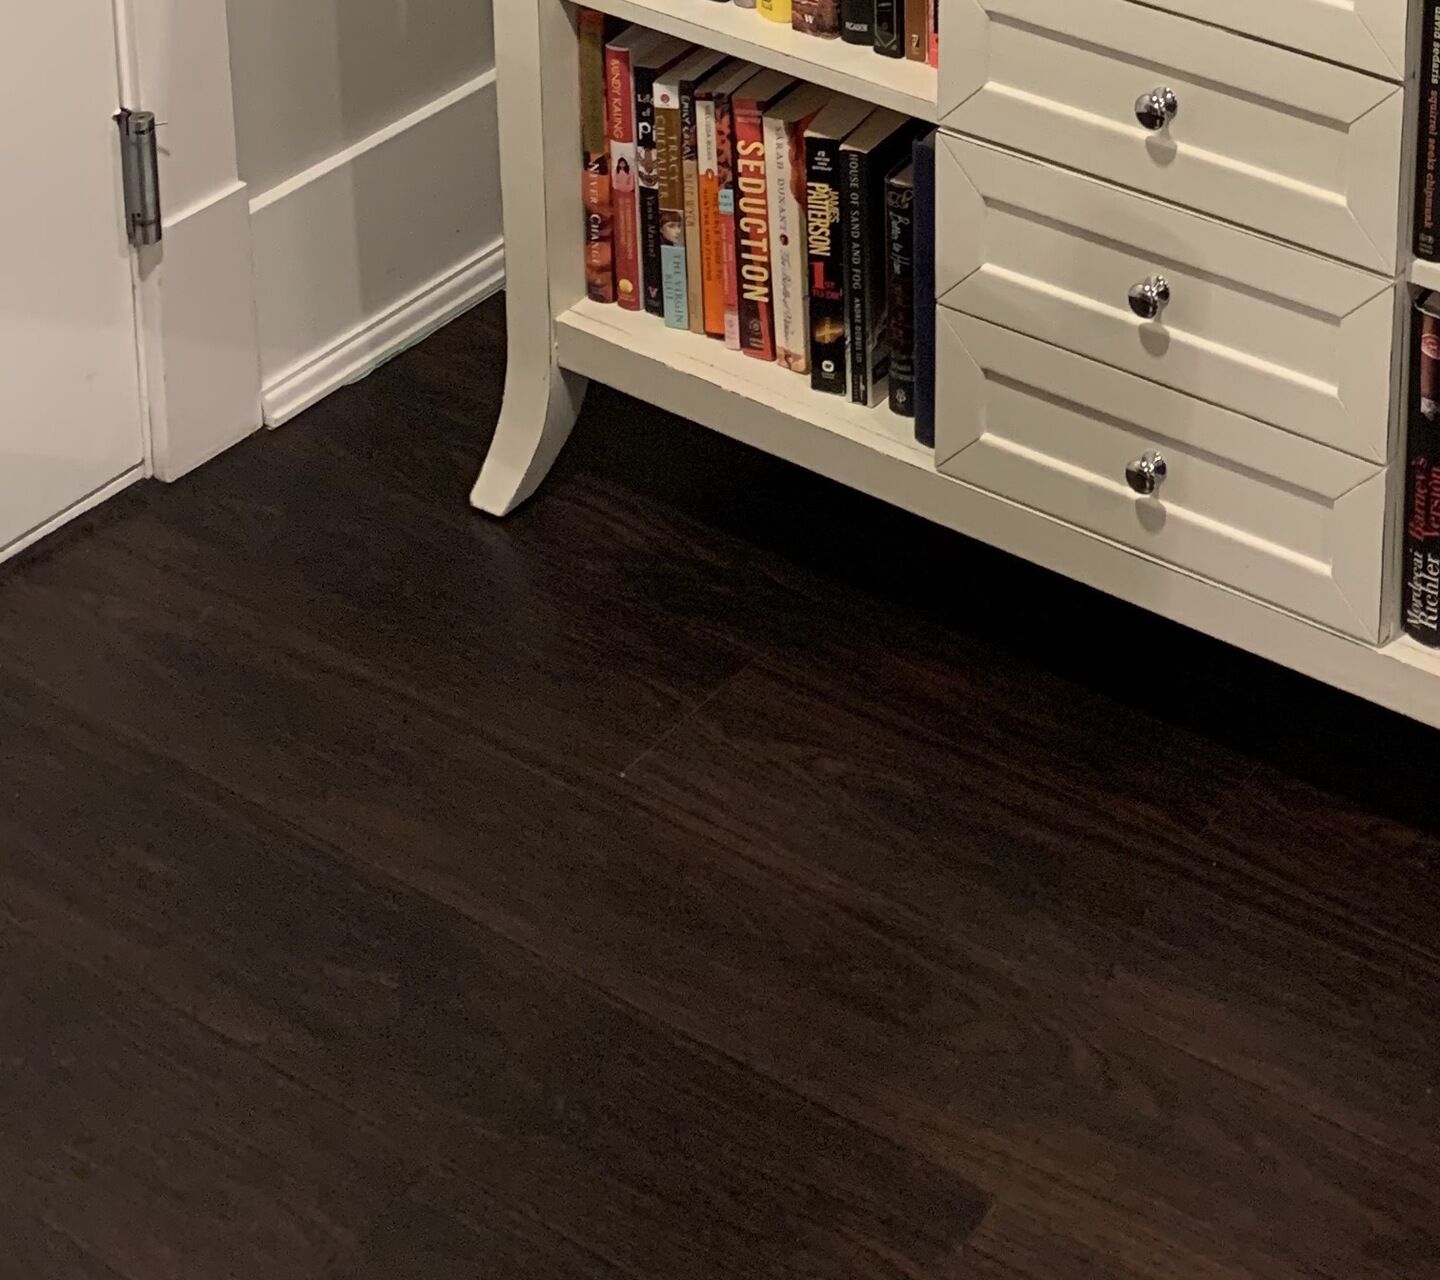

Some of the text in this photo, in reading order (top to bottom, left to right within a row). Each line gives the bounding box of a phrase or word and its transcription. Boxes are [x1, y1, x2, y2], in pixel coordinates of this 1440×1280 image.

[612, 98, 624, 139] KALING
[1427, 89, 1438, 136] squirrel
[656, 115, 669, 199] CHEVALIER
[668, 136, 679, 182] TRACY
[775, 126, 787, 232] SARAH DUNANT
[1426, 137, 1438, 171] seeks
[588, 160, 601, 264] NEVER CHANGE
[736, 140, 769, 304] SEDUCTION
[806, 181, 831, 256] PATTERSON
[828, 186, 839, 223] JAMES
[848, 153, 862, 291] HOUSE OF SAND AND FOG
[1423, 172, 1436, 229] chipmunk
[664, 274, 674, 300] BLUE
[673, 255, 685, 323] THE VIRGIN
[1408, 456, 1428, 541] Barney's
[1406, 548, 1423, 630] Mordecai
[1420, 552, 1440, 631] Richler
